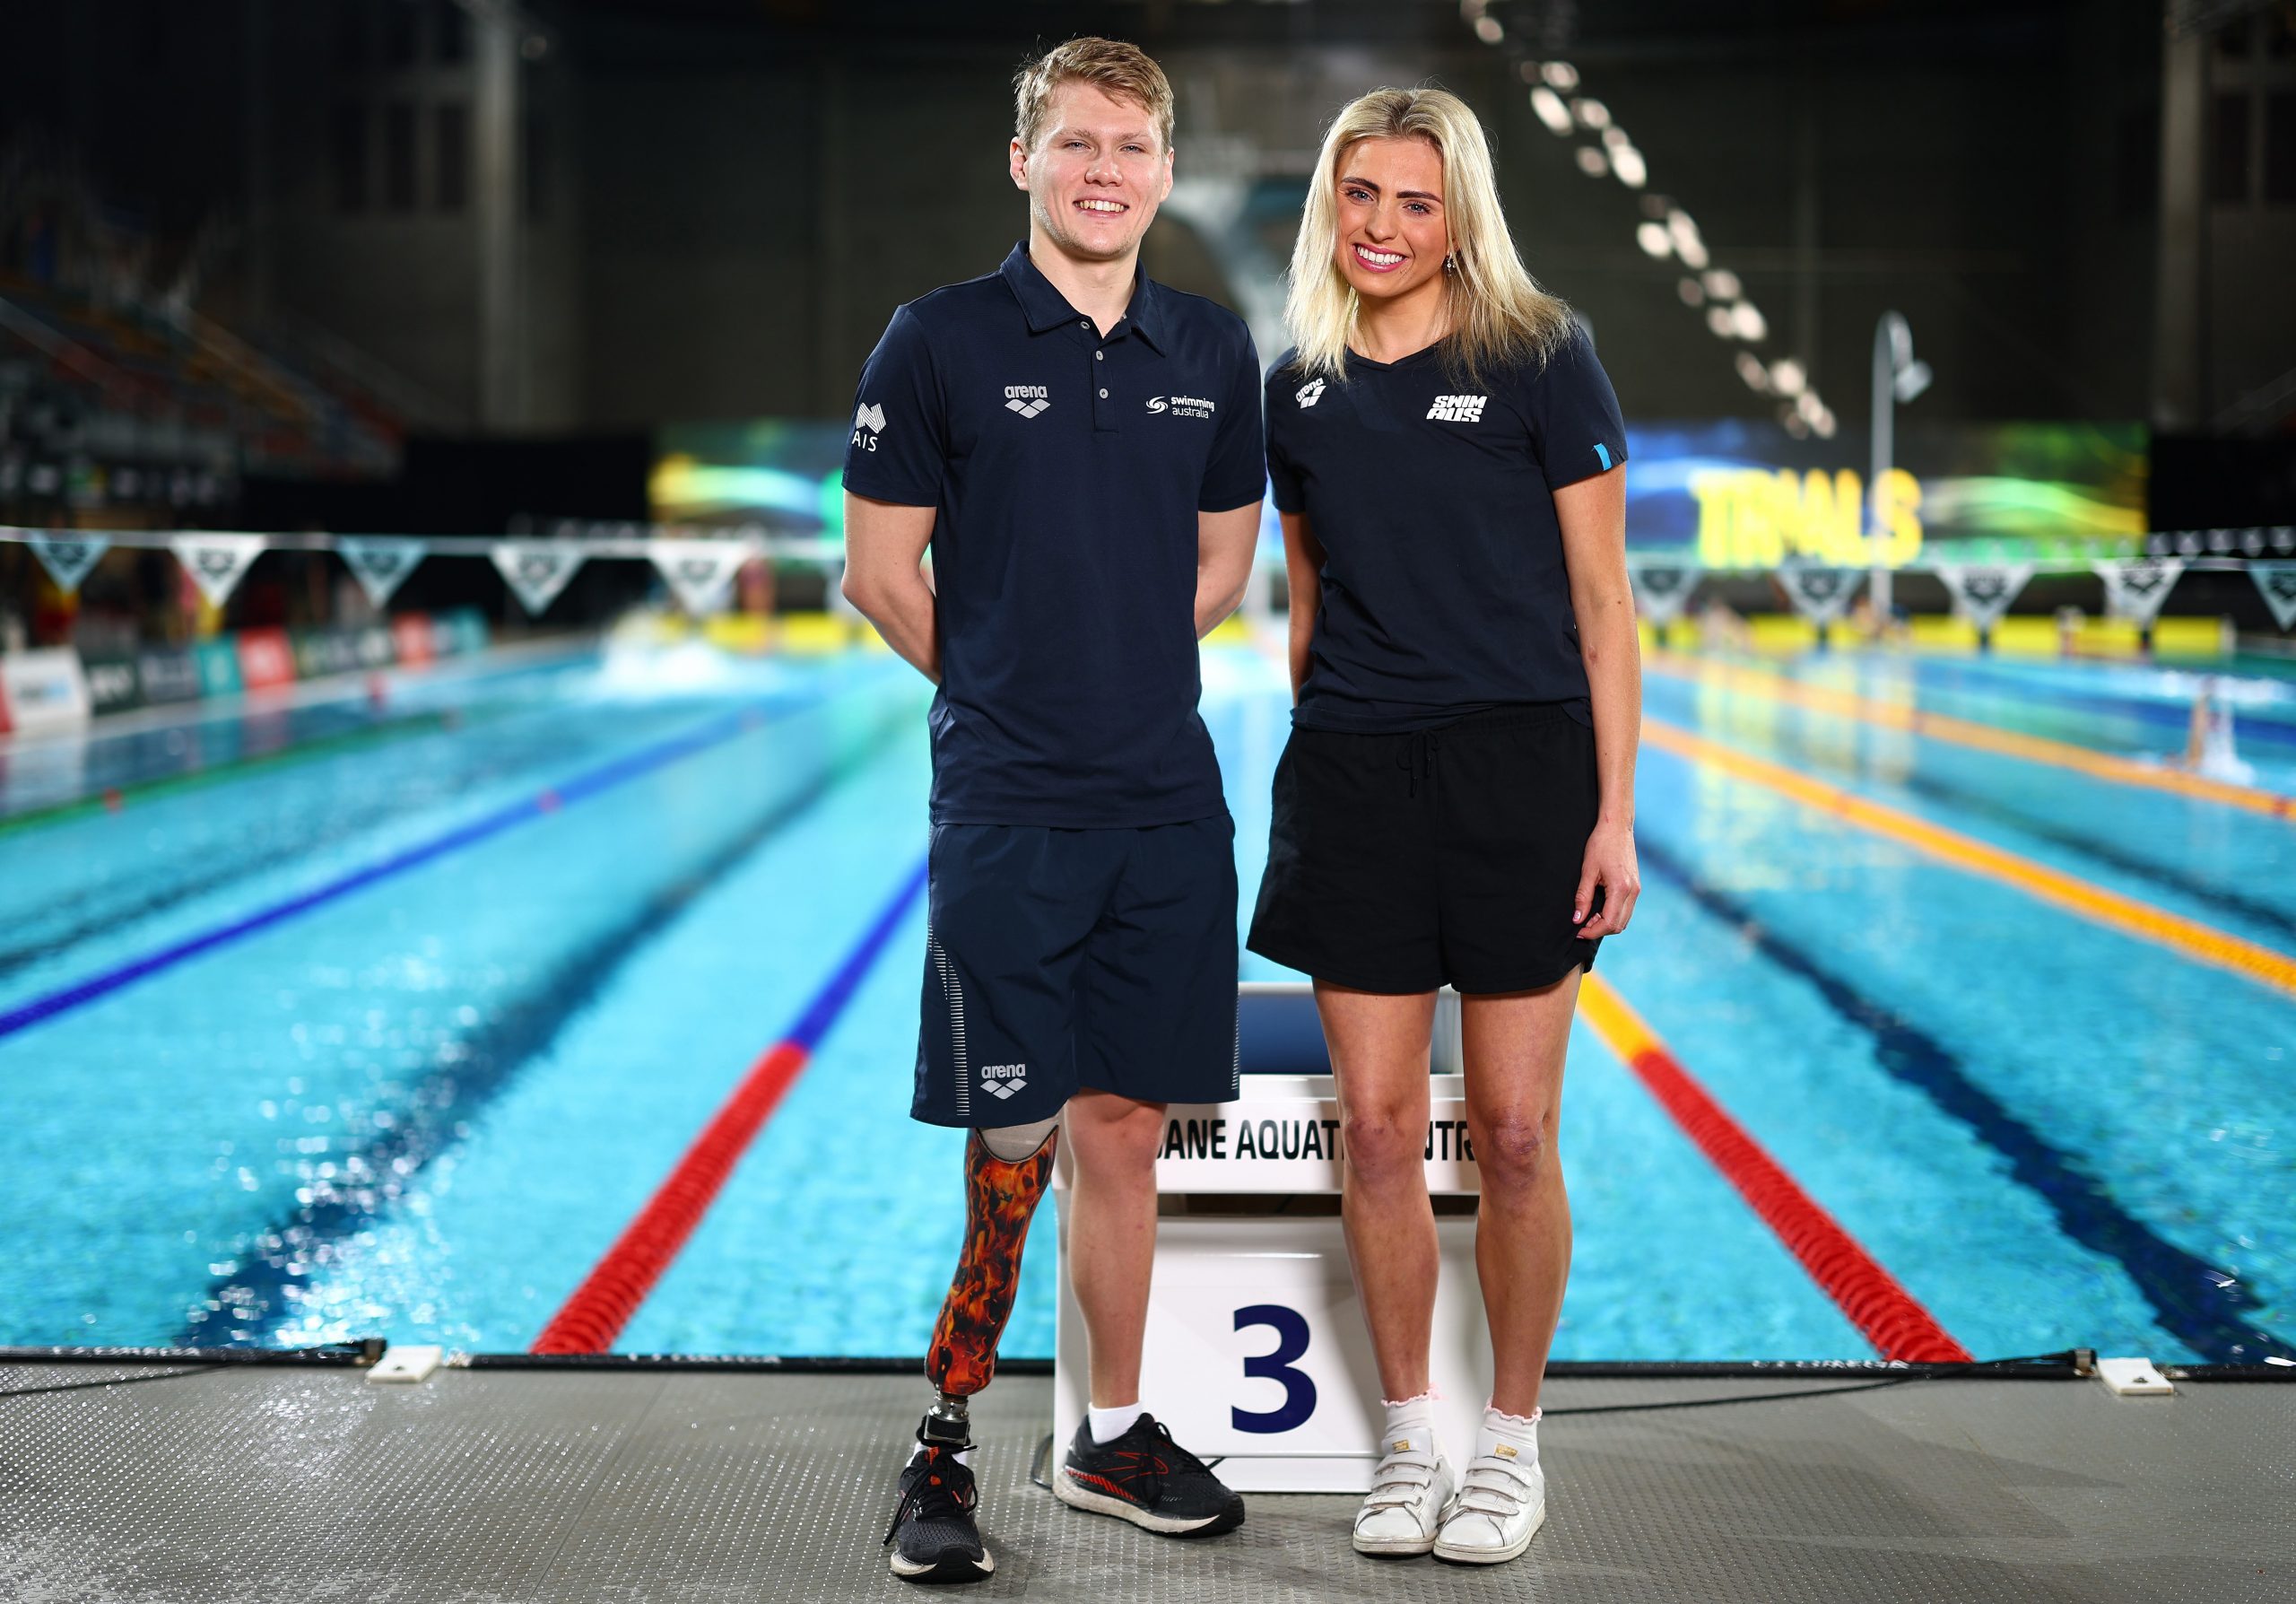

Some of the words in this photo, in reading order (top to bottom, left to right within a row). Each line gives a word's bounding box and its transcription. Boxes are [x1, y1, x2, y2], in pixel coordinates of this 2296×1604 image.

[1004, 384, 1048, 399] arena
[1295, 377, 1324, 403] arena
[1170, 395, 1215, 413] swimming
[1432, 395, 1488, 409] SWIM
[1172, 405, 1209, 420] australia
[1425, 407, 1483, 423] AUS
[851, 430, 879, 453] AIS
[980, 1063, 1026, 1079] arena
[1157, 1119, 1227, 1160] ANE
[1235, 1120, 1344, 1161] AQUAT
[1231, 1303, 1318, 1434] 3
